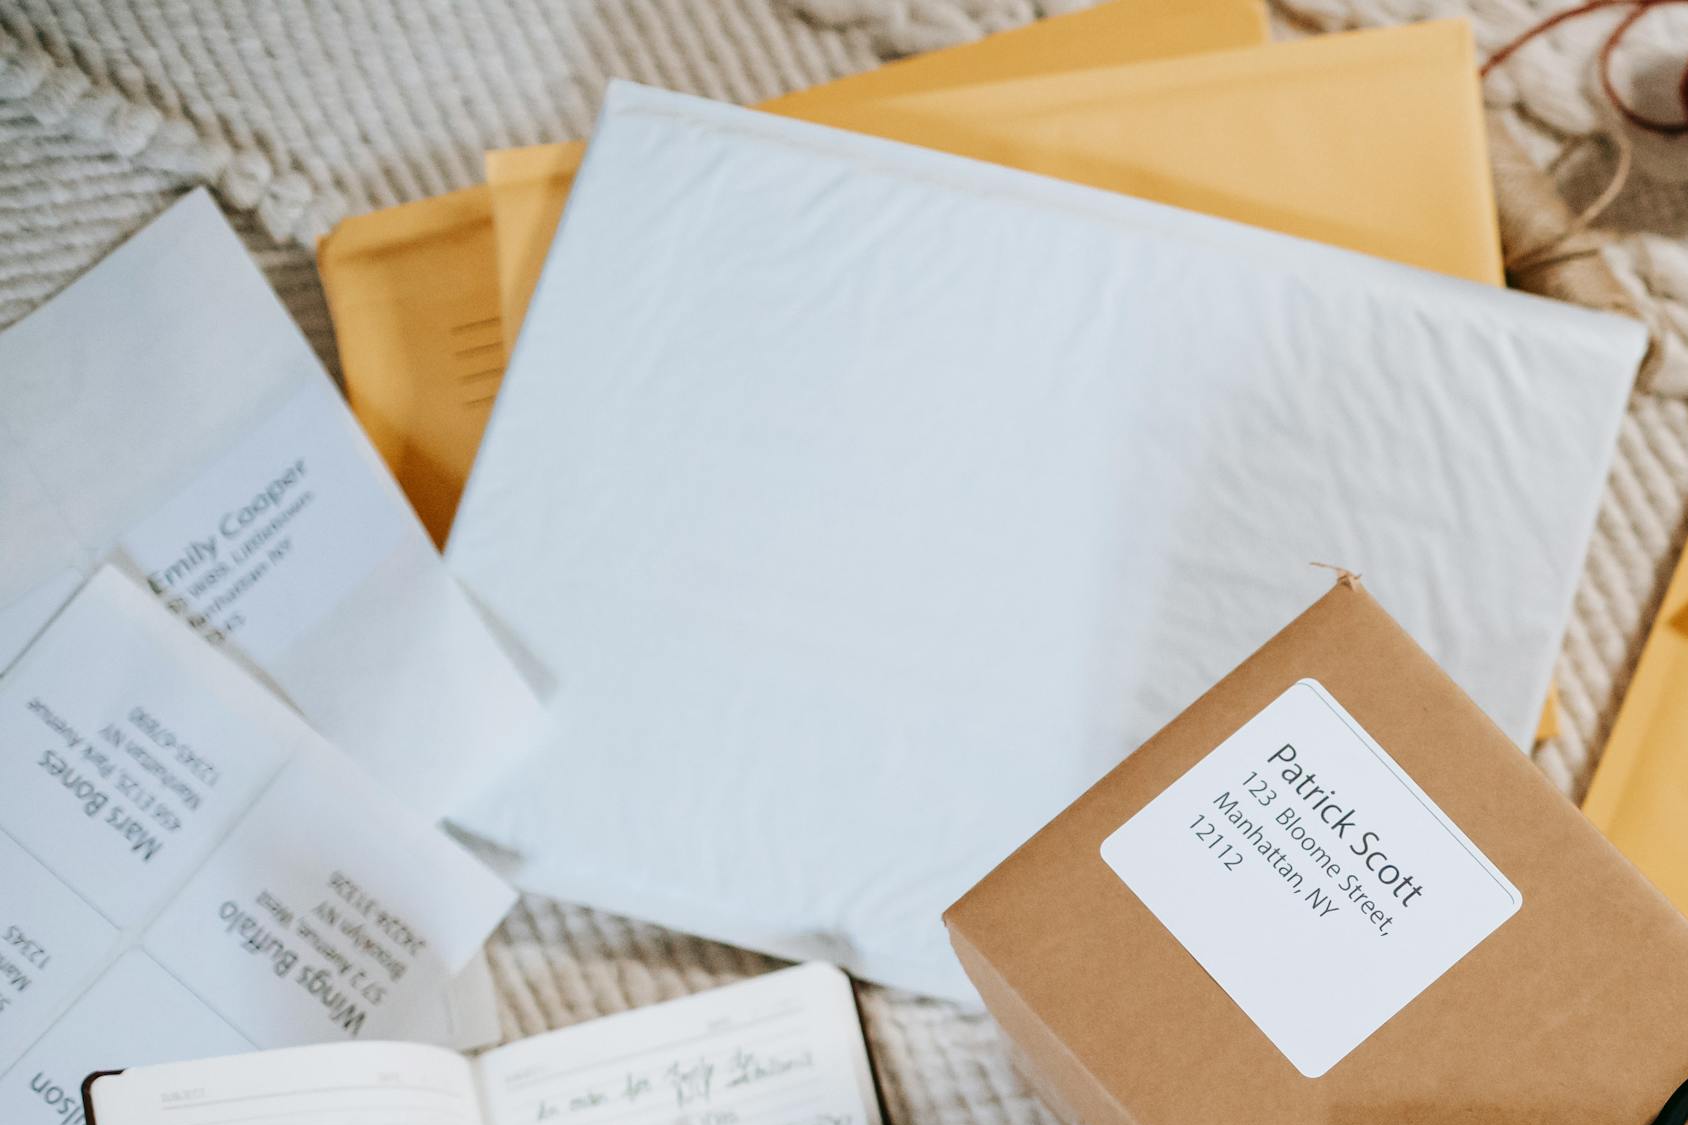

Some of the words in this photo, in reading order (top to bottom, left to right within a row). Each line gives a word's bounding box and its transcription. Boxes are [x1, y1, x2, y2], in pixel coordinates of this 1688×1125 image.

[219, 460, 306, 540] Cooper
[38, 750, 109, 818] Bones
[105, 806, 162, 862] Mars
[1190, 814, 1243, 871] 12112
[1213, 792, 1303, 894] Manhattan,
[1305, 888, 1339, 917] NY
[1243, 771, 1277, 807] 123
[1275, 809, 1341, 877] Bloome
[1338, 874, 1393, 936] Street,
[1267, 744, 1355, 837] Patrick
[1350, 832, 1422, 907] Scott
[219, 901, 299, 978] Buffalo
[296, 966, 366, 1037] Wings
